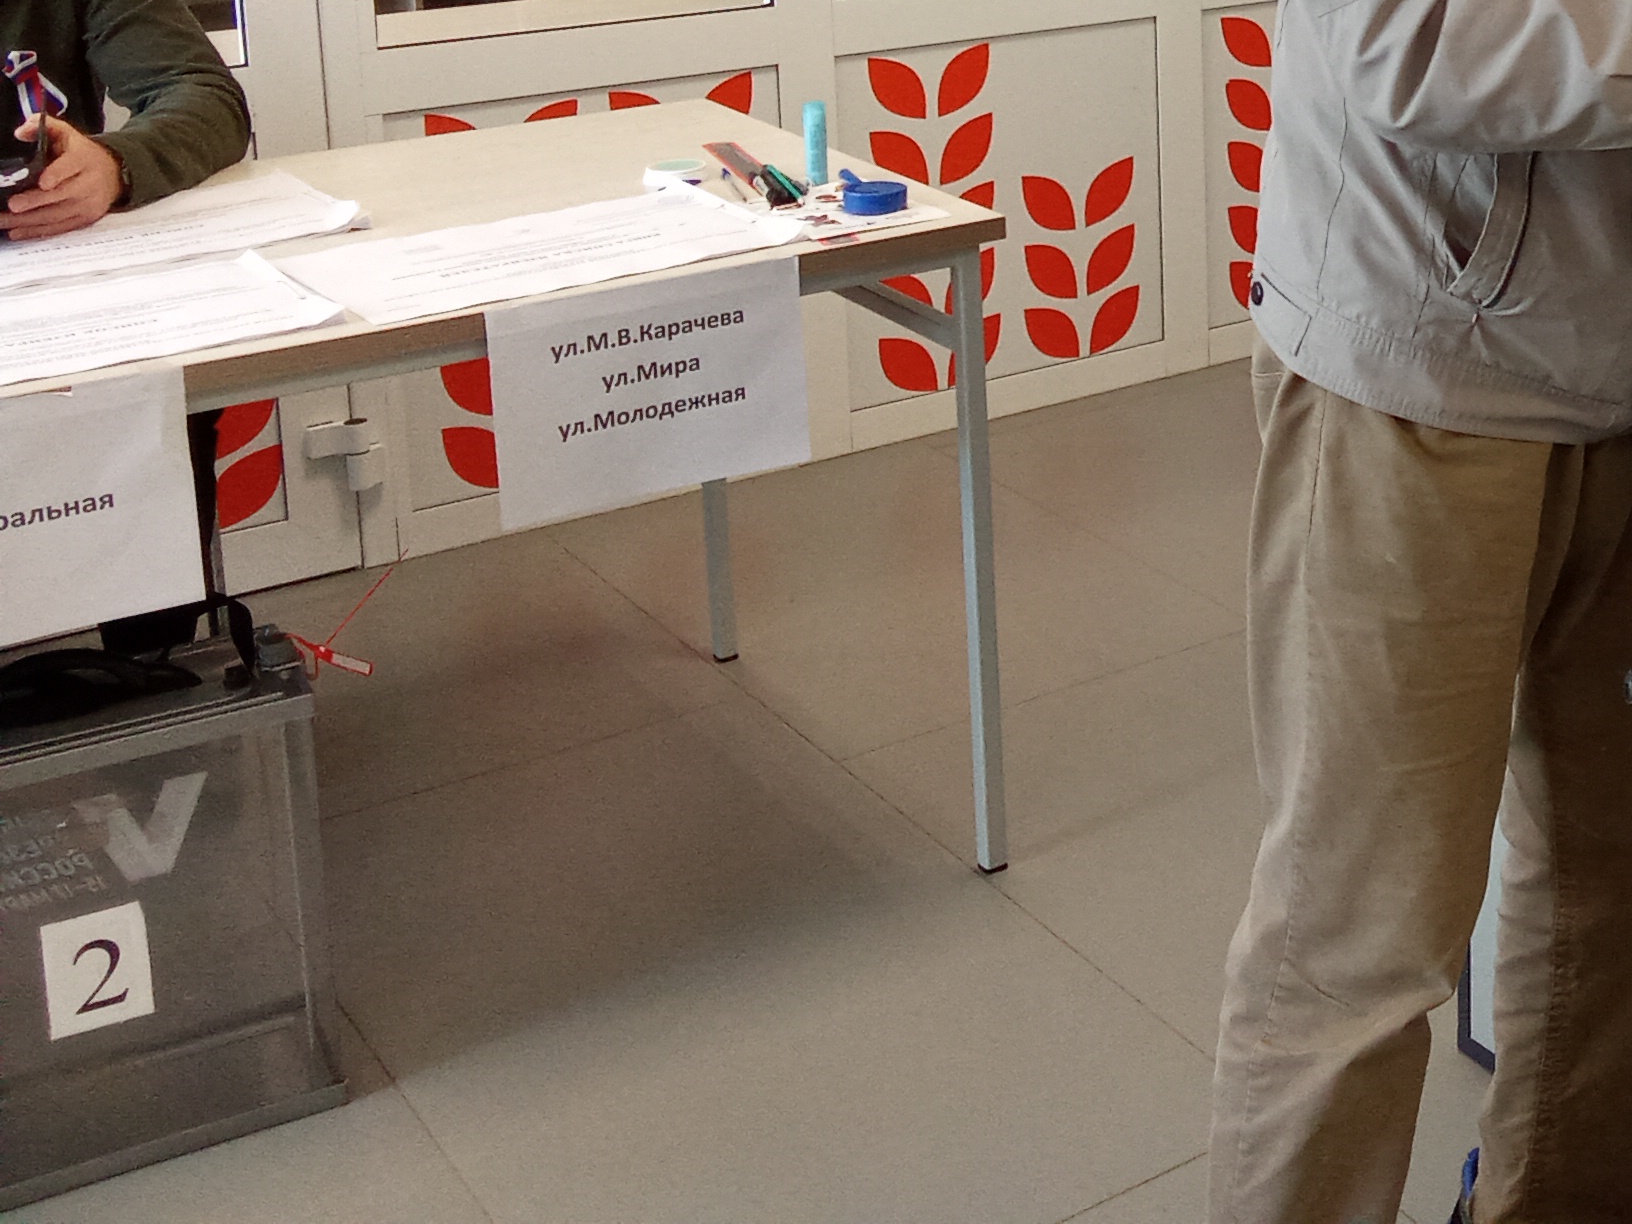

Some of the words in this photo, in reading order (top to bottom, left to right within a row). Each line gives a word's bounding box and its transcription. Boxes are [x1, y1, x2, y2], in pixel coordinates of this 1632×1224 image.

[551, 309, 745, 364] ул.М.В.Карачева
[602, 355, 700, 393] ул.Мира
[558, 385, 747, 443] ул.Молодежная
[72, 938, 129, 1015] 2
